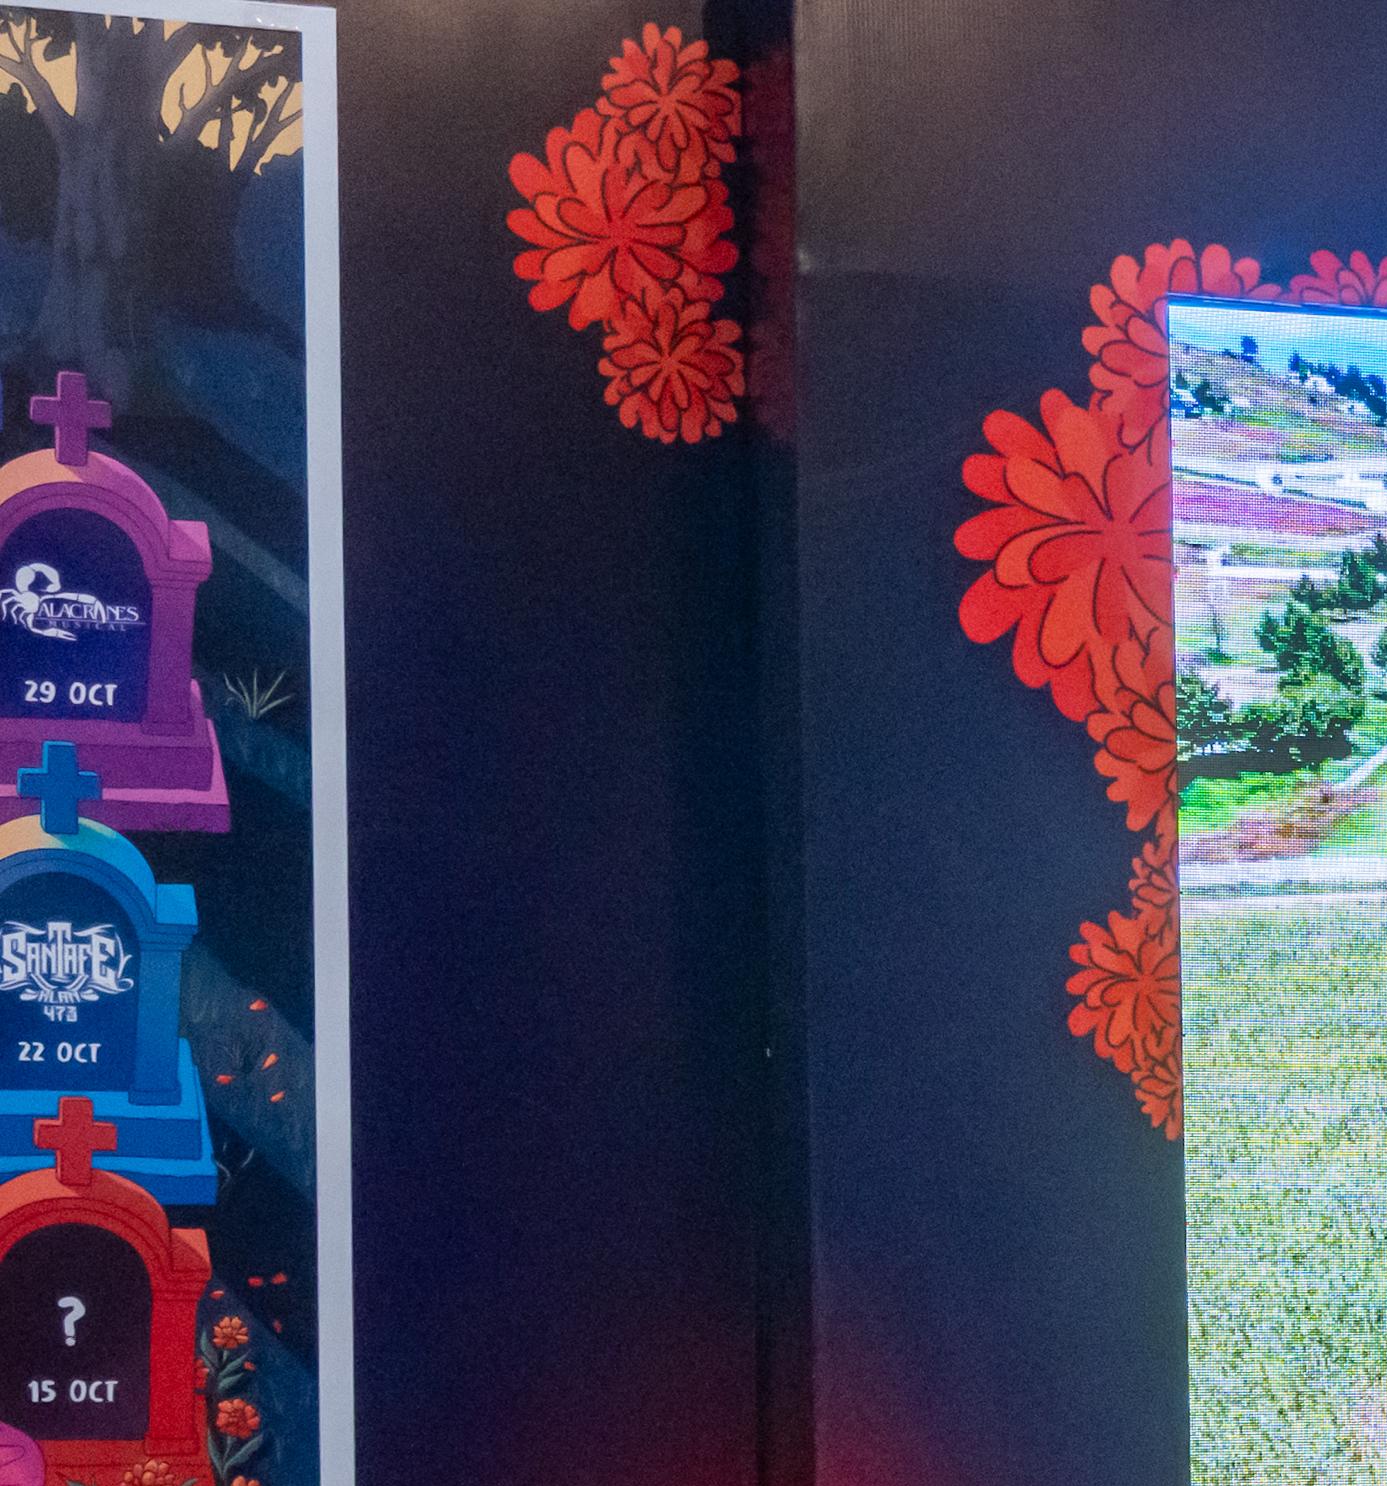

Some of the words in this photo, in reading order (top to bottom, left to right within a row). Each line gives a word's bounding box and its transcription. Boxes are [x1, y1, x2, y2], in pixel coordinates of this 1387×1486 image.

[38, 602, 139, 622] ALACRANES
[24, 680, 56, 703] 29
[69, 681, 118, 706] OCT
[18, 1041, 45, 1062] 22
[56, 1042, 102, 1063] OCT
[28, 1379, 57, 1403] 15
[69, 1379, 119, 1403] OCT
